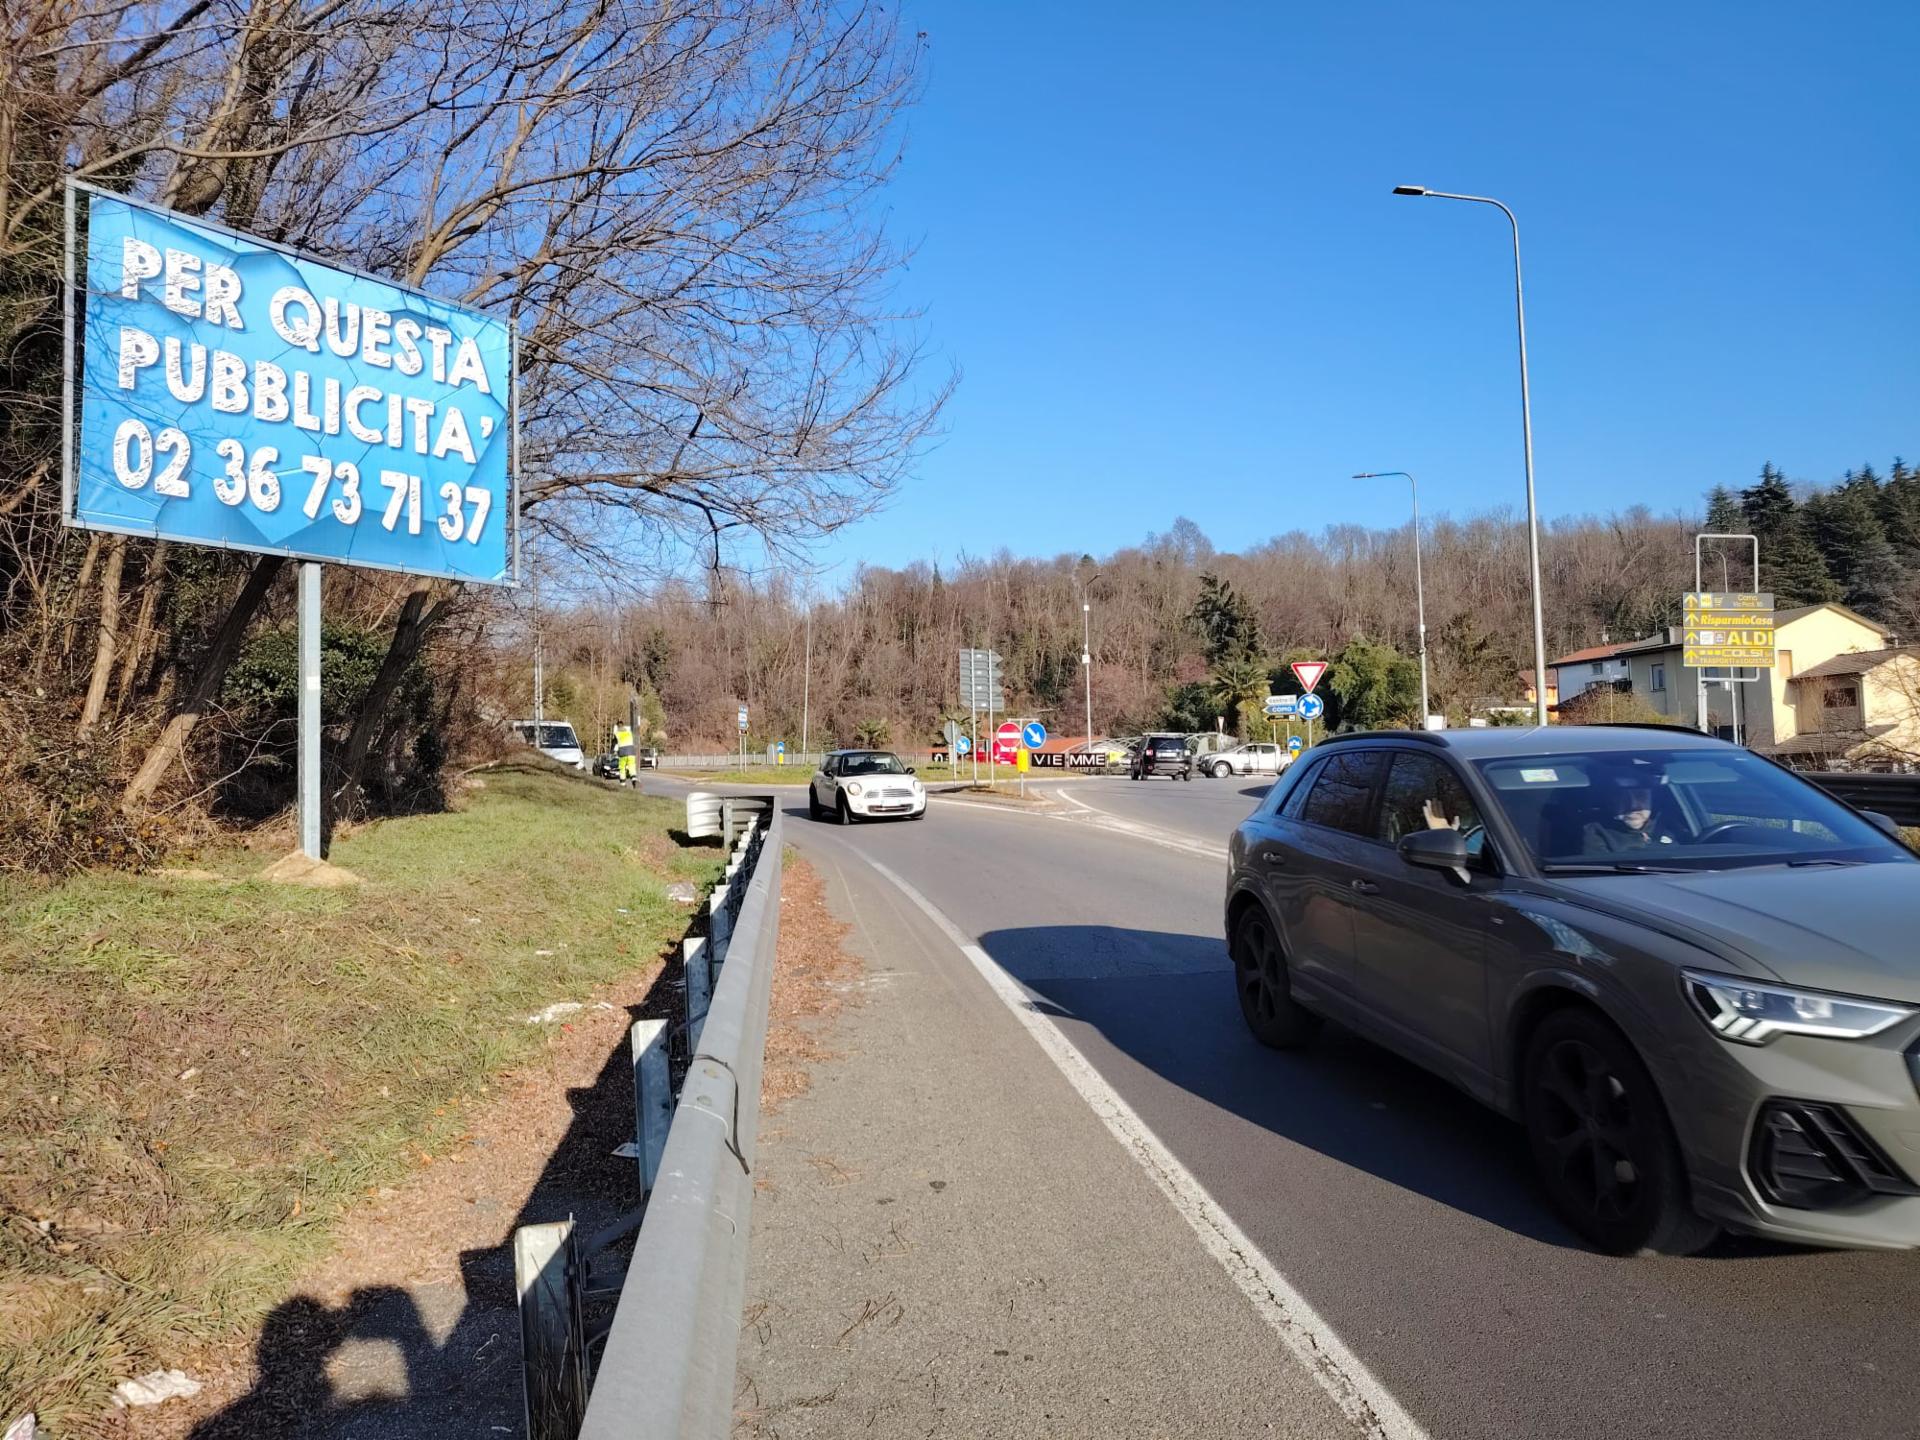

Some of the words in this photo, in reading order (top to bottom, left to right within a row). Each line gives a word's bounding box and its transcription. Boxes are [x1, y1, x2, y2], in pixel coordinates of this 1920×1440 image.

[121, 236, 243, 330] PER
[269, 286, 489, 393] QUESTA
[112, 418, 191, 498] 02
[215, 438, 281, 513] 36
[301, 456, 362, 525] 73
[380, 471, 422, 535] 71
[438, 481, 491, 545] 37
[1727, 631, 1773, 645] ALDI
[1034, 754, 1063, 766] VIE
[1070, 754, 1105, 766] MME
